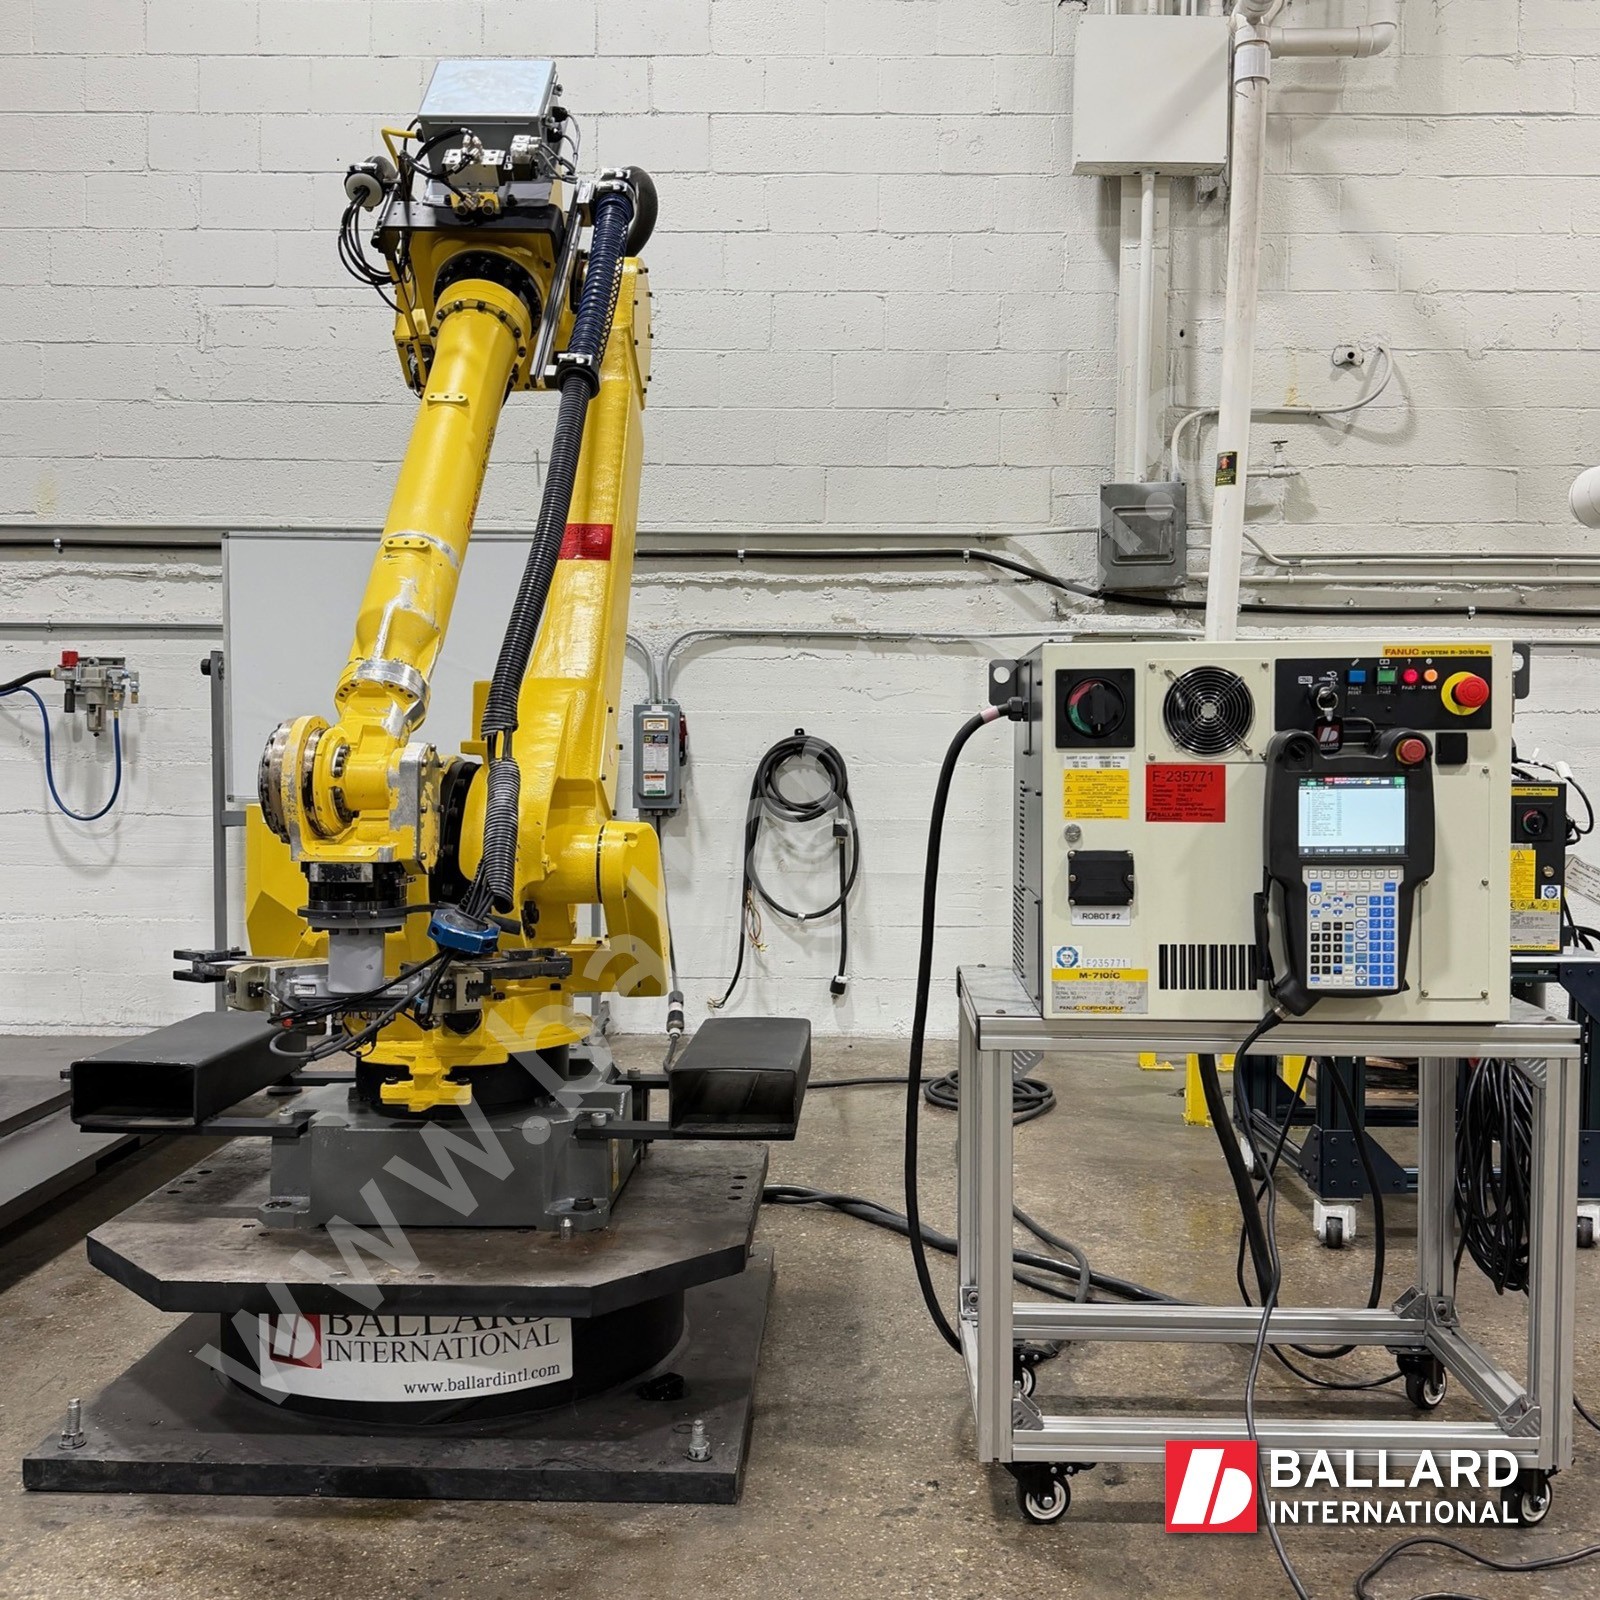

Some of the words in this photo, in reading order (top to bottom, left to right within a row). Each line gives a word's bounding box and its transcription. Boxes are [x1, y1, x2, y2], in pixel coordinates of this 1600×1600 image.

[1385, 648, 1419, 656] FANUC
[1152, 770, 1214, 783] F-235771
[1086, 959, 1127, 968] F235771
[1079, 970, 1120, 979] M-710iC
[326, 1323, 560, 1364] INTERNATIONAL
[403, 1362, 560, 1395] www.ballardintl.com
